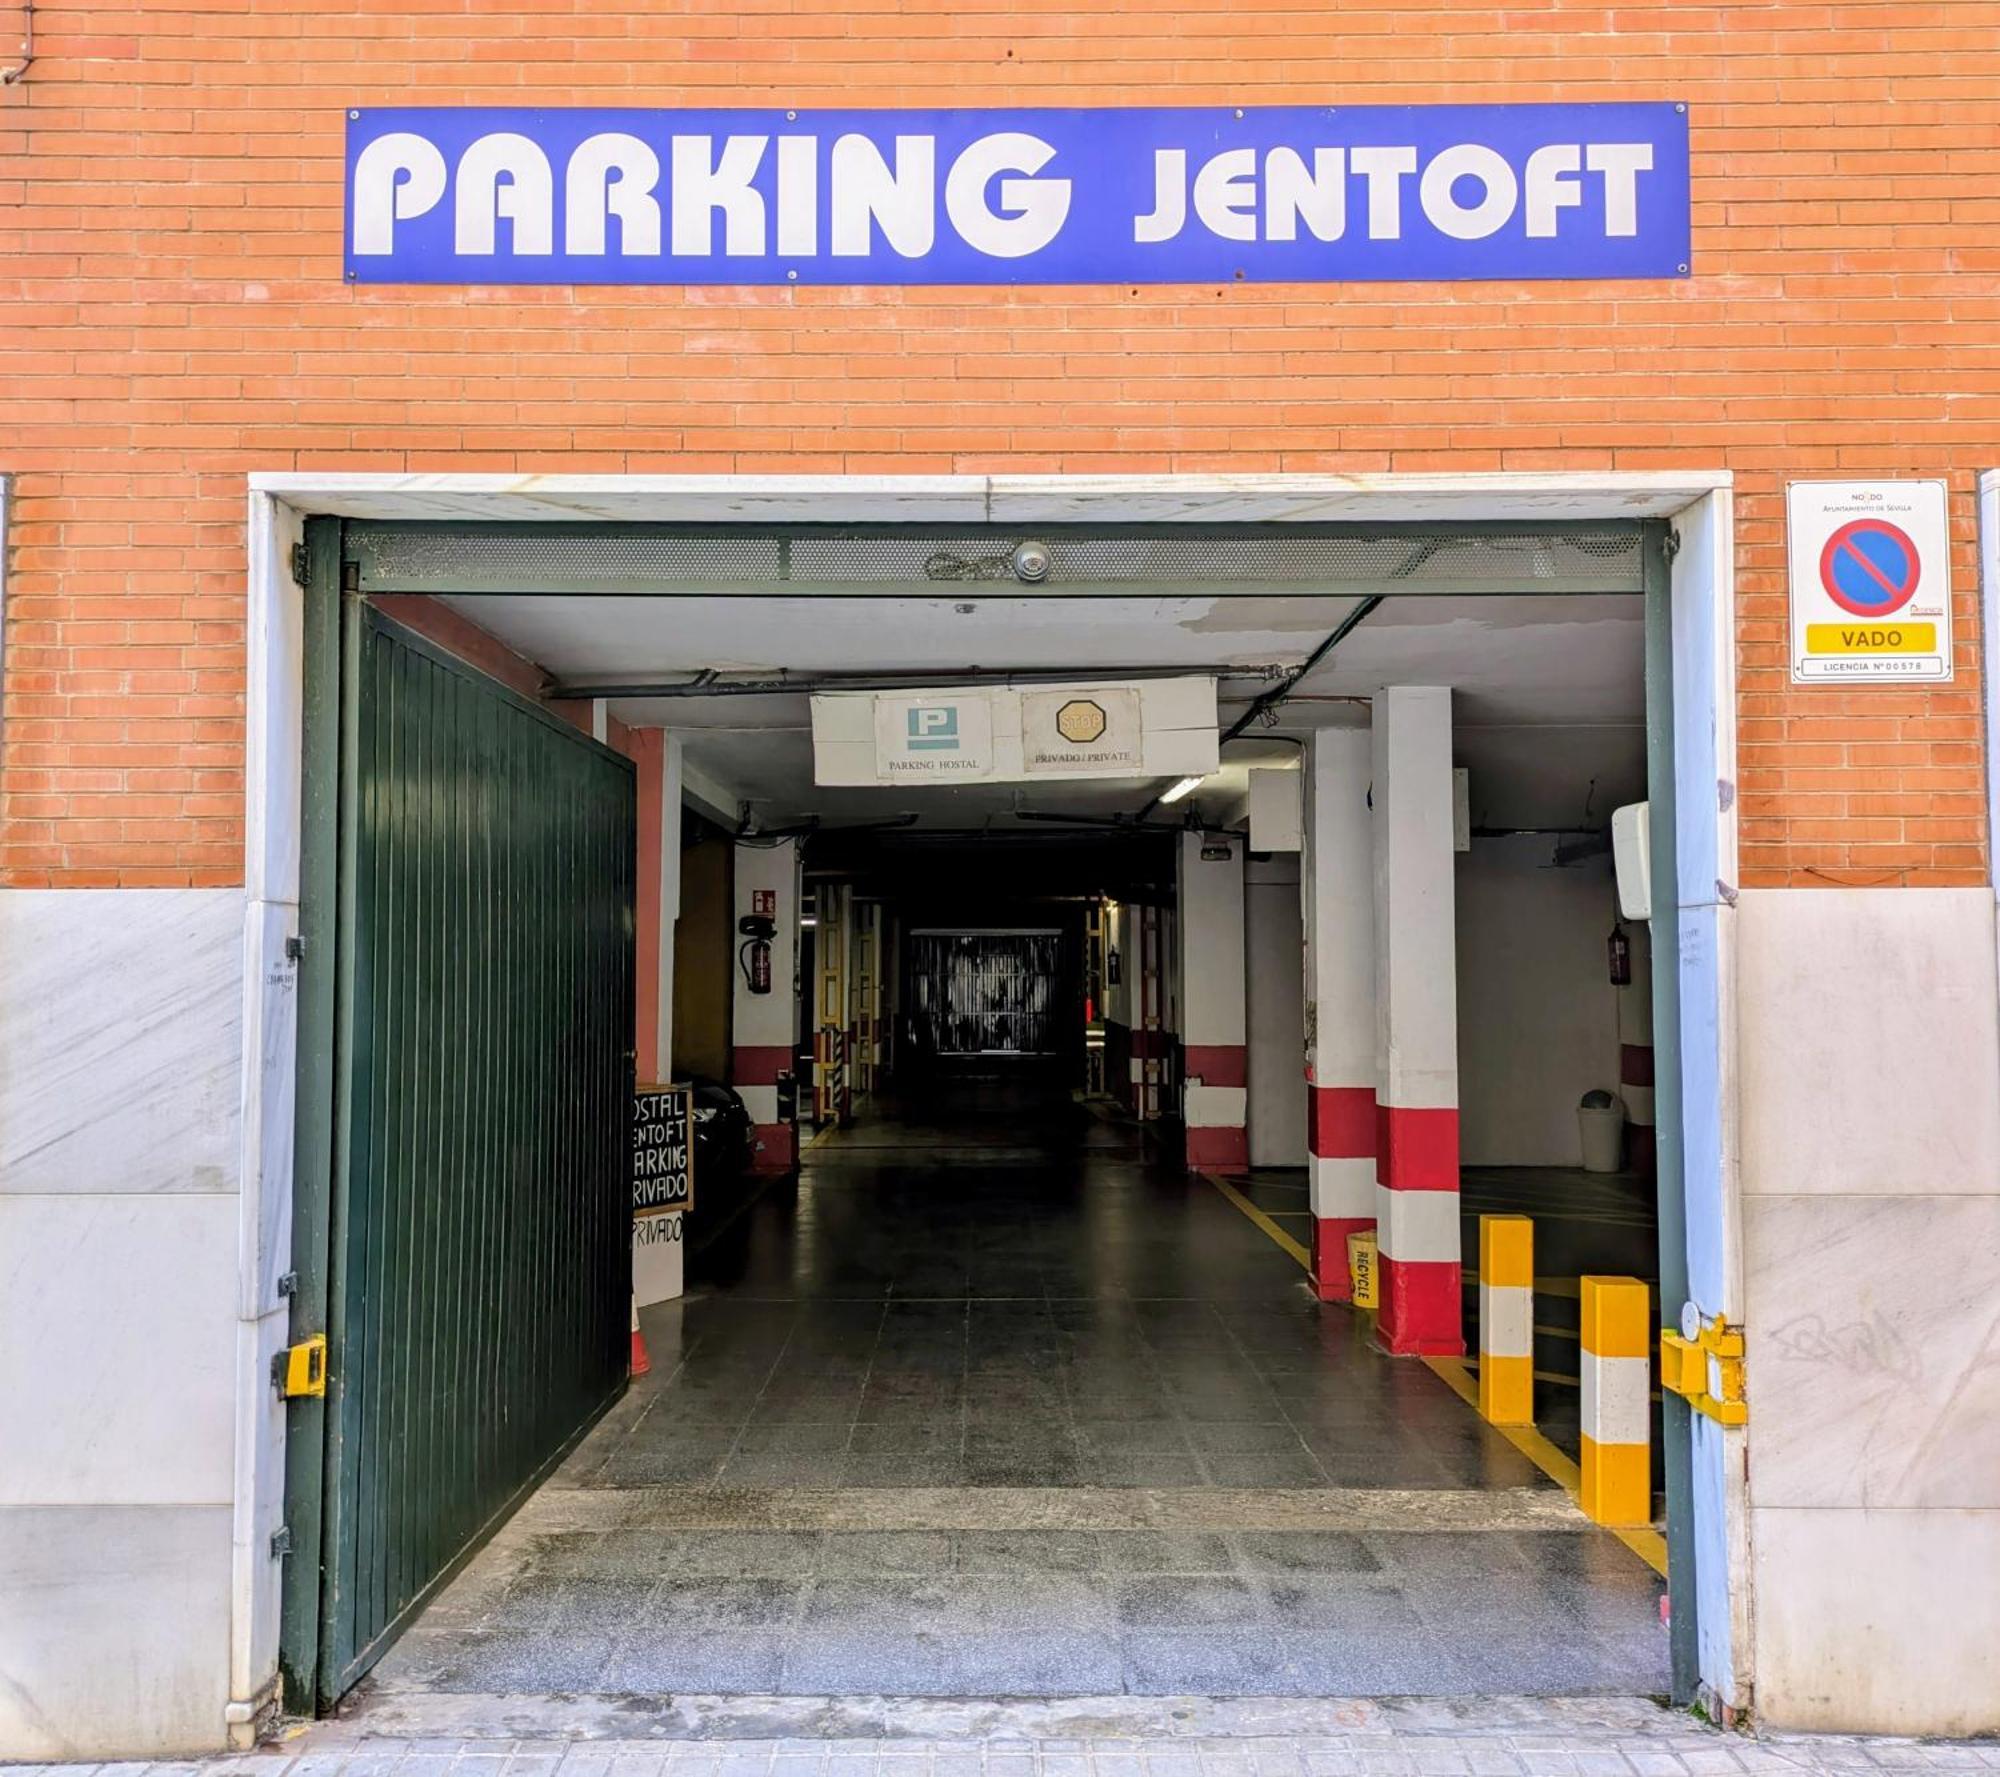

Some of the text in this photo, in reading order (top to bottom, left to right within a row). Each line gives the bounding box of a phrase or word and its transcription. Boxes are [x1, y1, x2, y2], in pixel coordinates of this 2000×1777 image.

[354, 133, 1653, 257] PARKING JENTOFT
[1842, 631, 1902, 647] VADO
[1824, 663, 1869, 672] LICENCIA
[919, 709, 948, 735] P
[1061, 713, 1102, 730] STOP
[889, 759, 980, 771] PARKING HOSTAL
[634, 1145, 687, 1176] ARKING
[633, 1173, 687, 1207] RIVADO
[1357, 1251, 1369, 1299] RECYCLE
